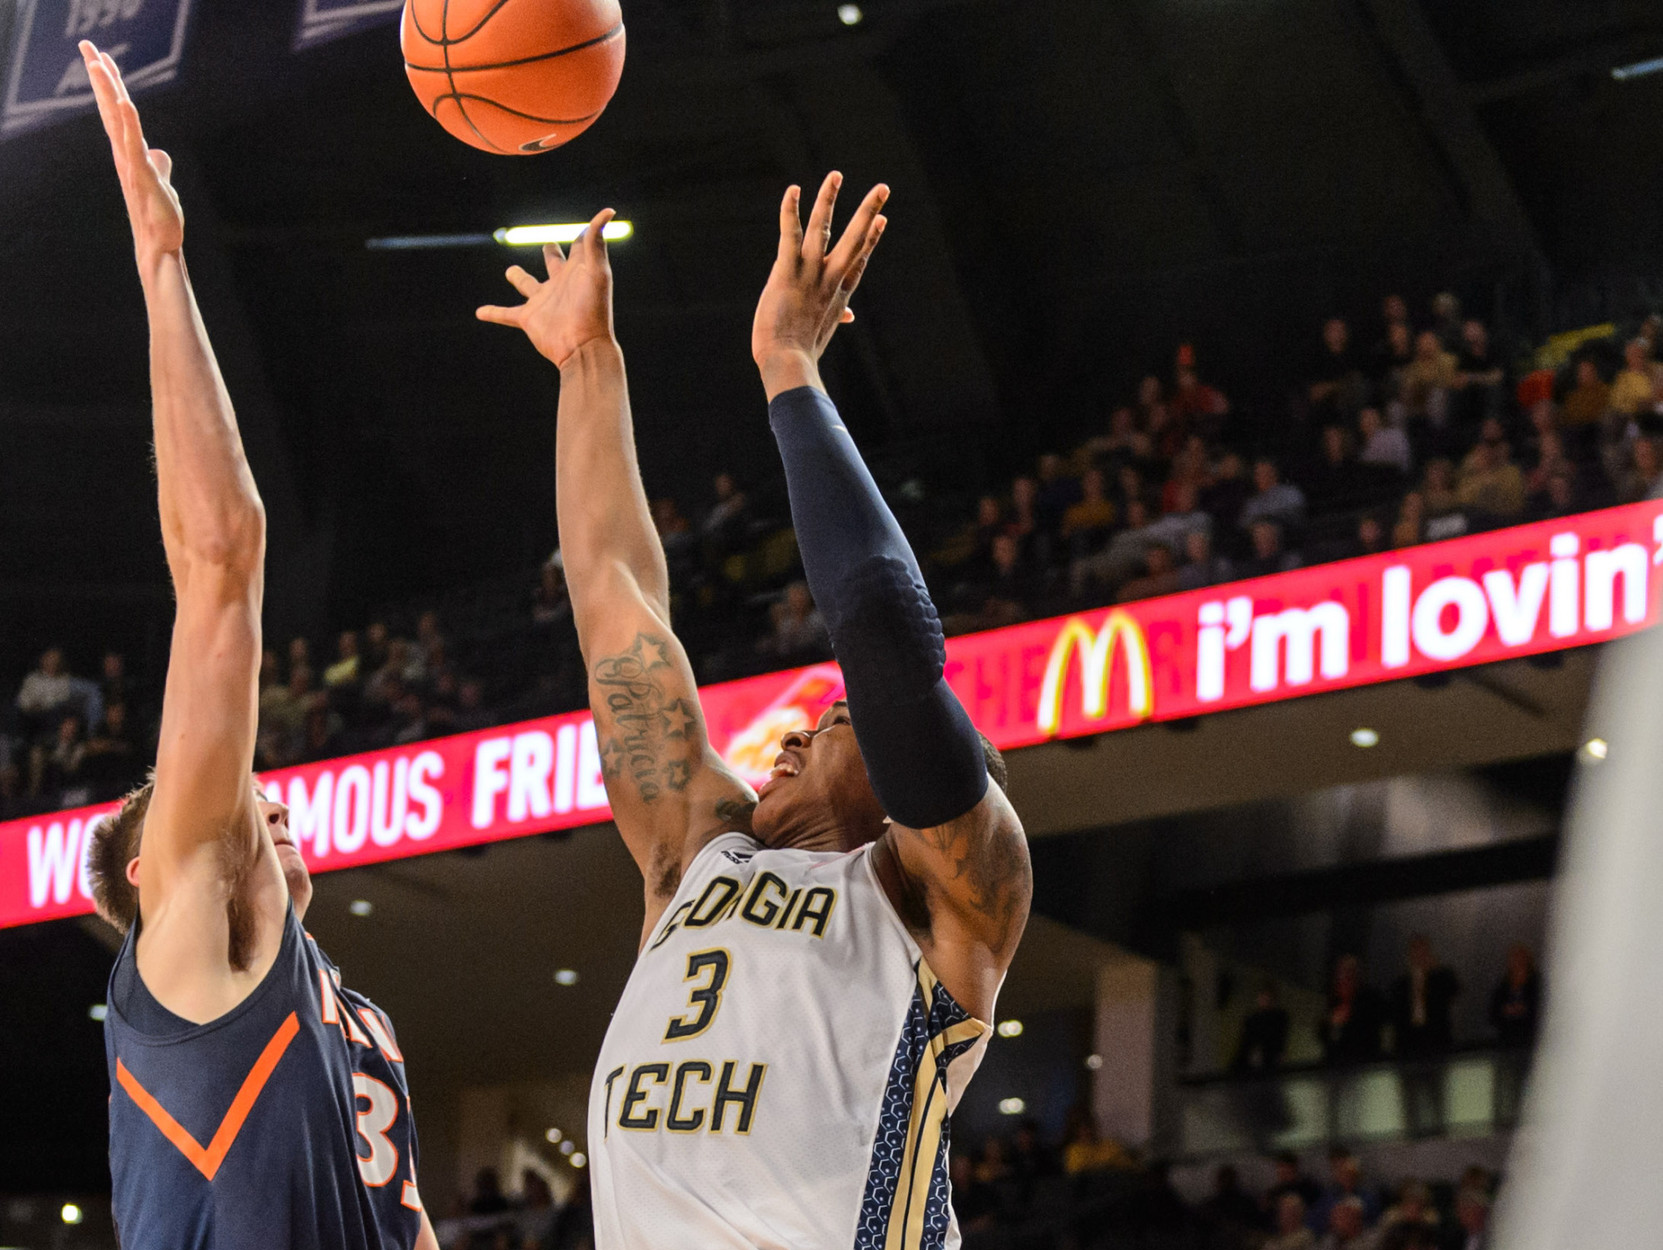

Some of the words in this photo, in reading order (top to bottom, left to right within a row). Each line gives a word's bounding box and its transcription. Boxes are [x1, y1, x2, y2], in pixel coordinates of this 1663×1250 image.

[1196, 595, 1349, 702] i'm
[660, 946, 732, 1045] 3
[603, 1058, 768, 1143] TECH
